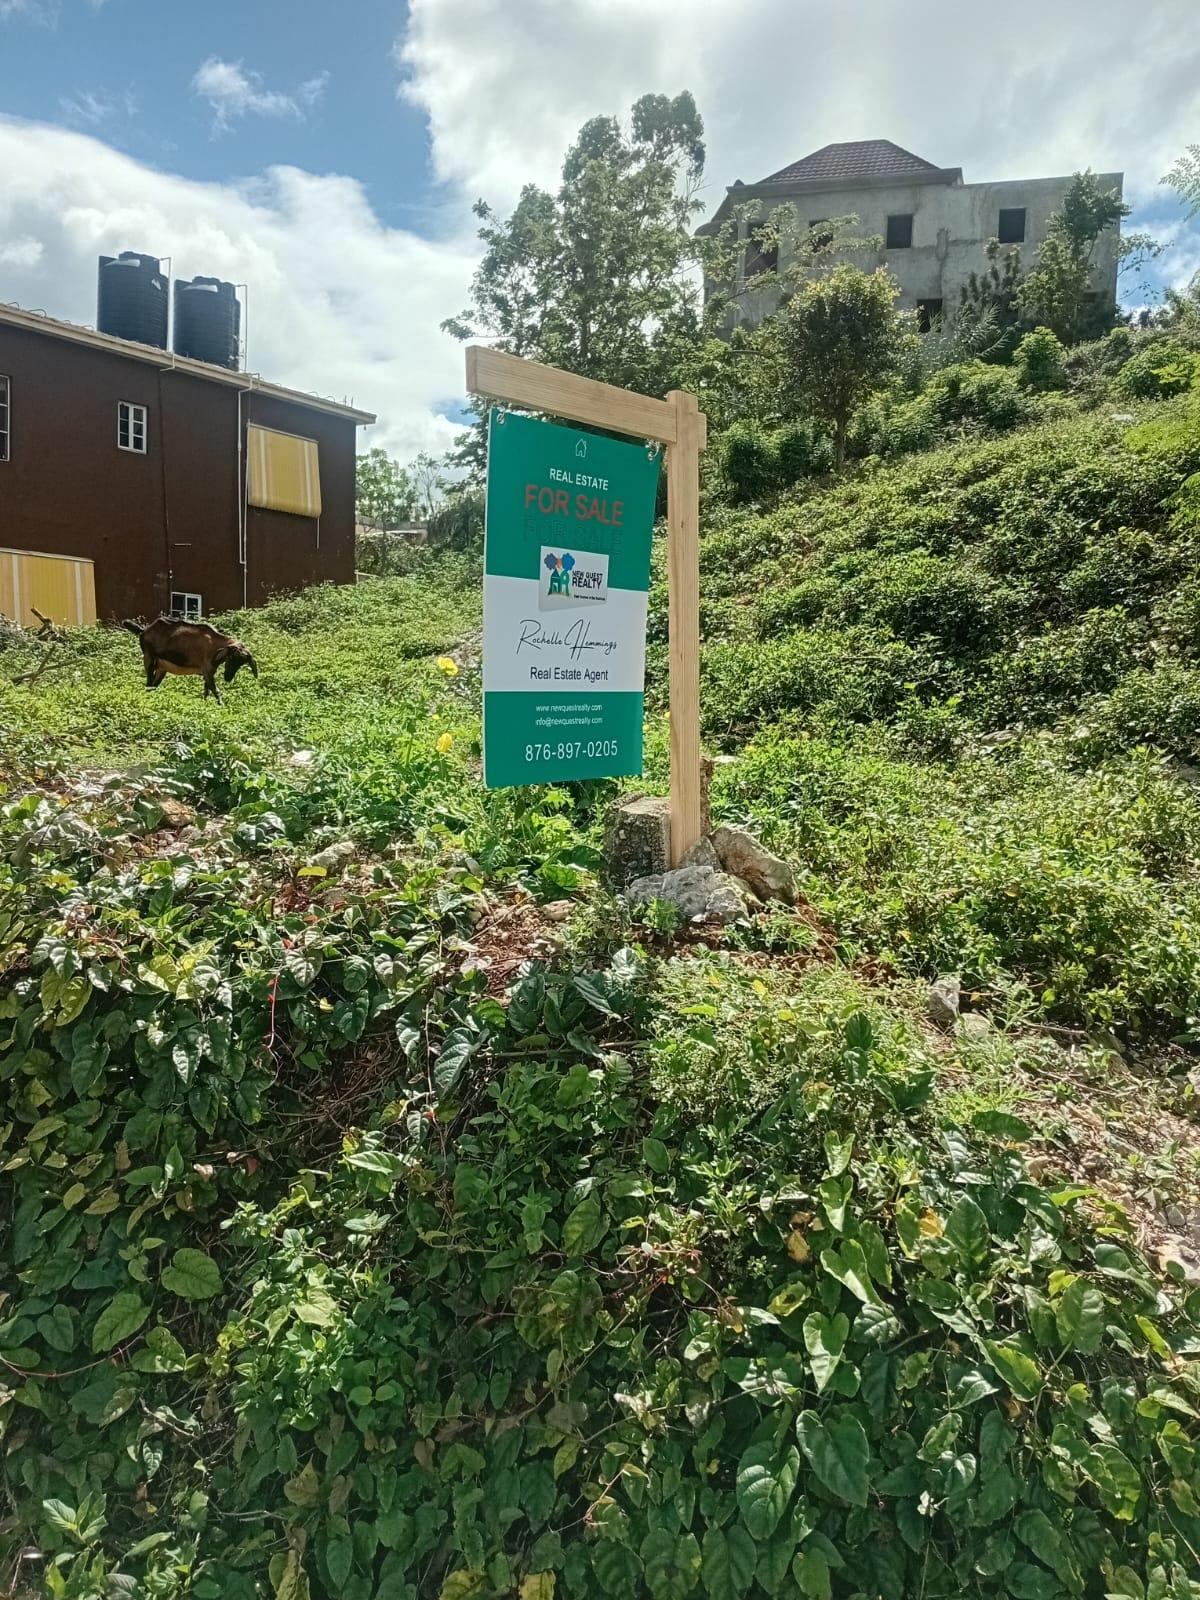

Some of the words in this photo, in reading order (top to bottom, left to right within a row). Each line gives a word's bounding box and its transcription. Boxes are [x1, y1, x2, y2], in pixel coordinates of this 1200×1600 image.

[549, 468, 574, 484] REAL
[575, 473, 609, 491] ESTATE
[524, 484, 569, 517] FOR
[575, 494, 624, 527] SALE
[572, 570, 585, 578] NEW
[572, 577, 602, 589] REALTY
[516, 619, 562, 654] Rochelle
[564, 619, 617, 661] Hemmings
[530, 666, 551, 680] Real
[554, 667, 581, 680] Estate
[584, 668, 608, 683] Agent
[535, 704, 603, 713] www.newquestrealty.com
[525, 740, 618, 761] 876-897-0205
